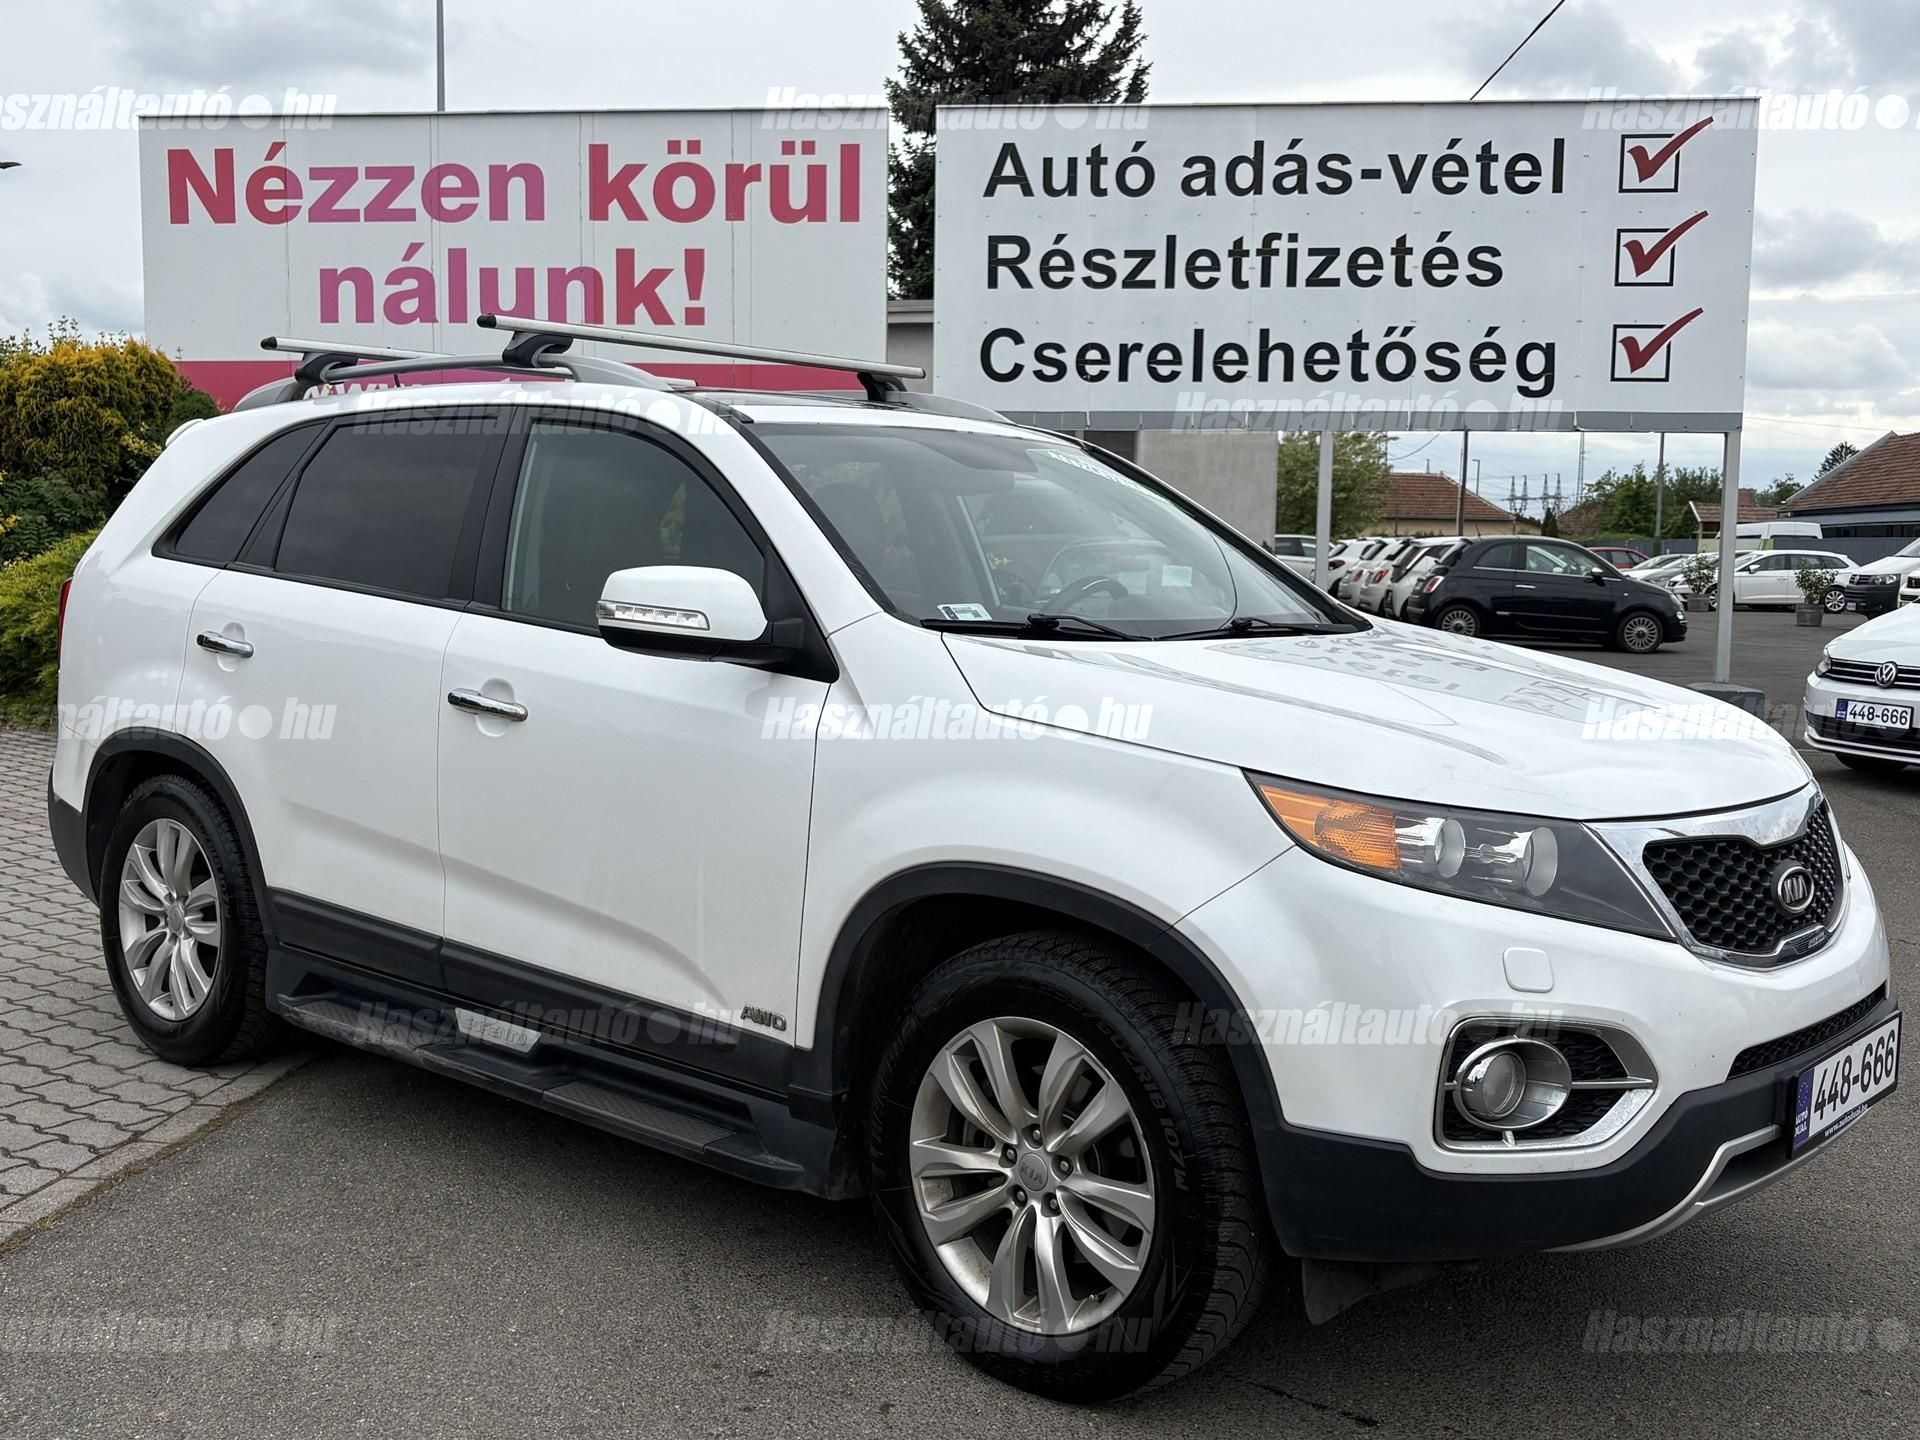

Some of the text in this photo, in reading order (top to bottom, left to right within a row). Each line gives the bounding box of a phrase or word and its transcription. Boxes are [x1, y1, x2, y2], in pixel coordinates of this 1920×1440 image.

[167, 139, 861, 225] Nézzen körül
[982, 137, 1566, 198] Autó adás-vétel
[319, 241, 706, 326] nálunk!
[987, 230, 1504, 290] Részletfizetés
[979, 325, 1557, 398] Cserelehetőség
[1849, 703, 1909, 726] 448-666
[740, 1005, 787, 1031] AWD
[1813, 1029, 1896, 1120] 448-666
